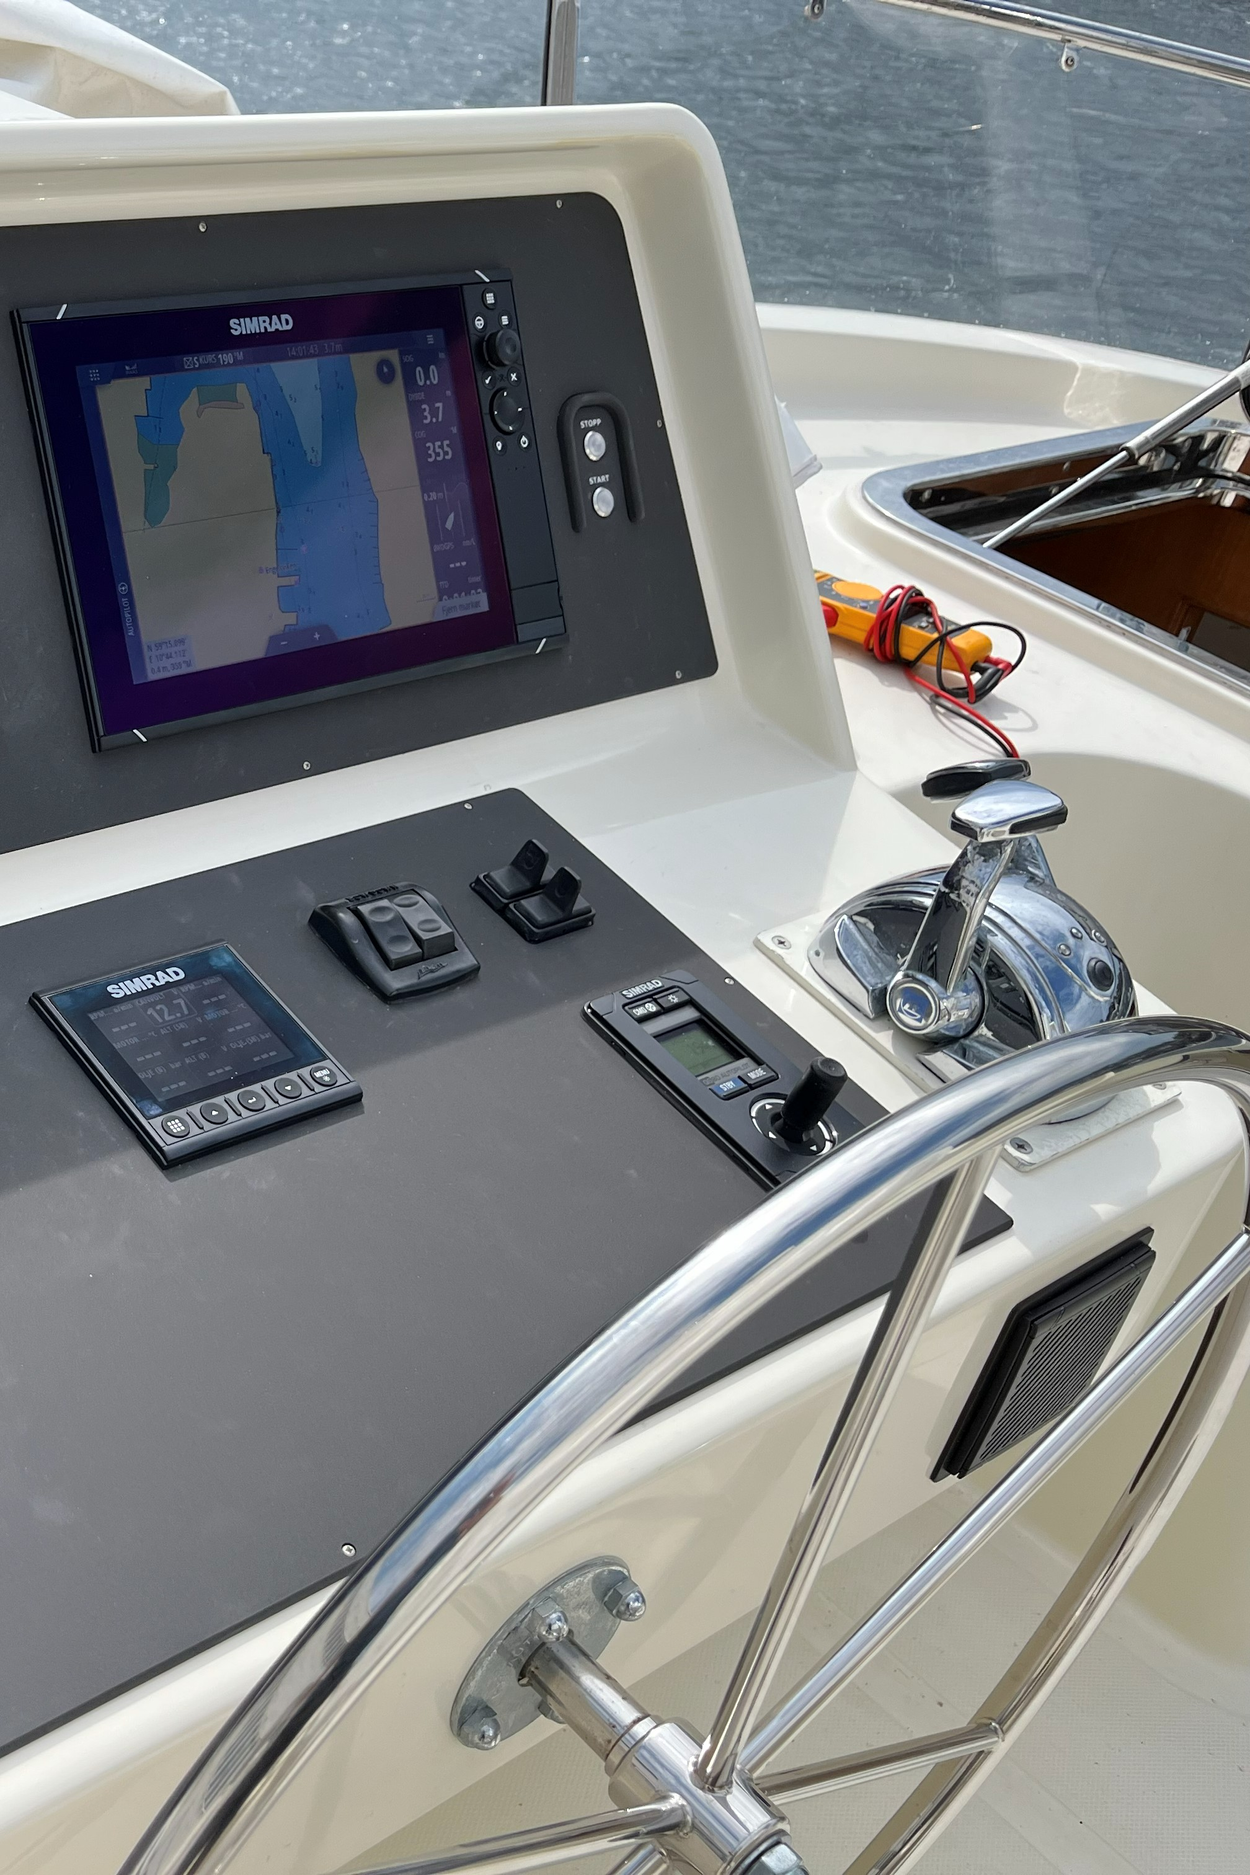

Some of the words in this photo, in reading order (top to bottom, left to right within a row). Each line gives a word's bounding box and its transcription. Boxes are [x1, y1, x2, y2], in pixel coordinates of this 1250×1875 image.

[229, 313, 293, 335] SIMRAD
[200, 354, 217, 364] KURS
[218, 353, 234, 365] 190
[416, 365, 438, 386] 0.0
[421, 402, 443, 424] 3.7
[580, 418, 601, 428] STOPP
[426, 440, 452, 462] 355
[589, 474, 610, 485] START
[121, 597, 135, 637] AUTOPILOT
[106, 966, 186, 999] SIMRAD
[621, 980, 662, 998] SIMRAD
[147, 998, 189, 1023] 12.7
[314, 1068, 330, 1078] MENU
[747, 1068, 766, 1079] MODE
[720, 1080, 736, 1091] STBY
